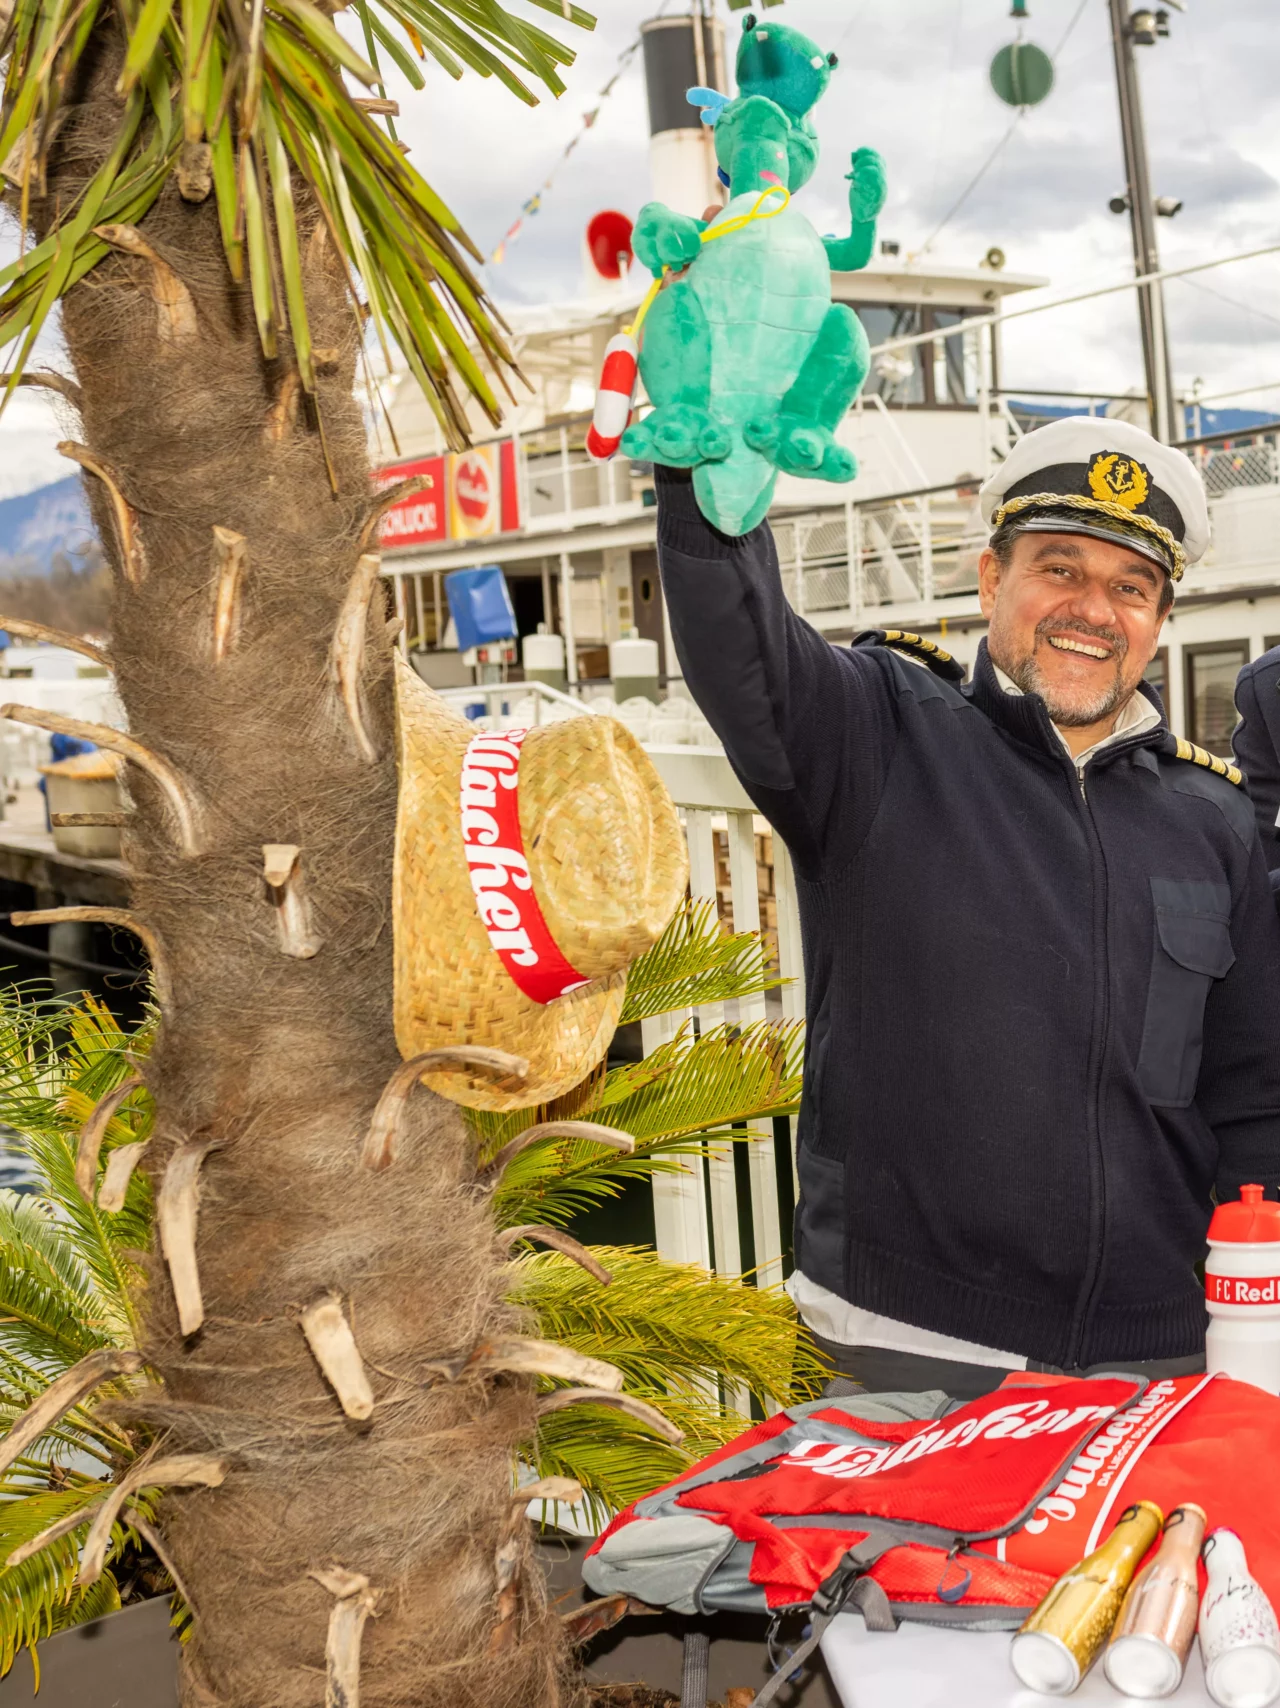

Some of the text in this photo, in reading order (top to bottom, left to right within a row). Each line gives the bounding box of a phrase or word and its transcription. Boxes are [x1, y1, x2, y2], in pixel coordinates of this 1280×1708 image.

[1216, 1279, 1231, 1301] FC
[1236, 1280, 1275, 1302] Red
[1096, 1469, 1114, 1486] DA
